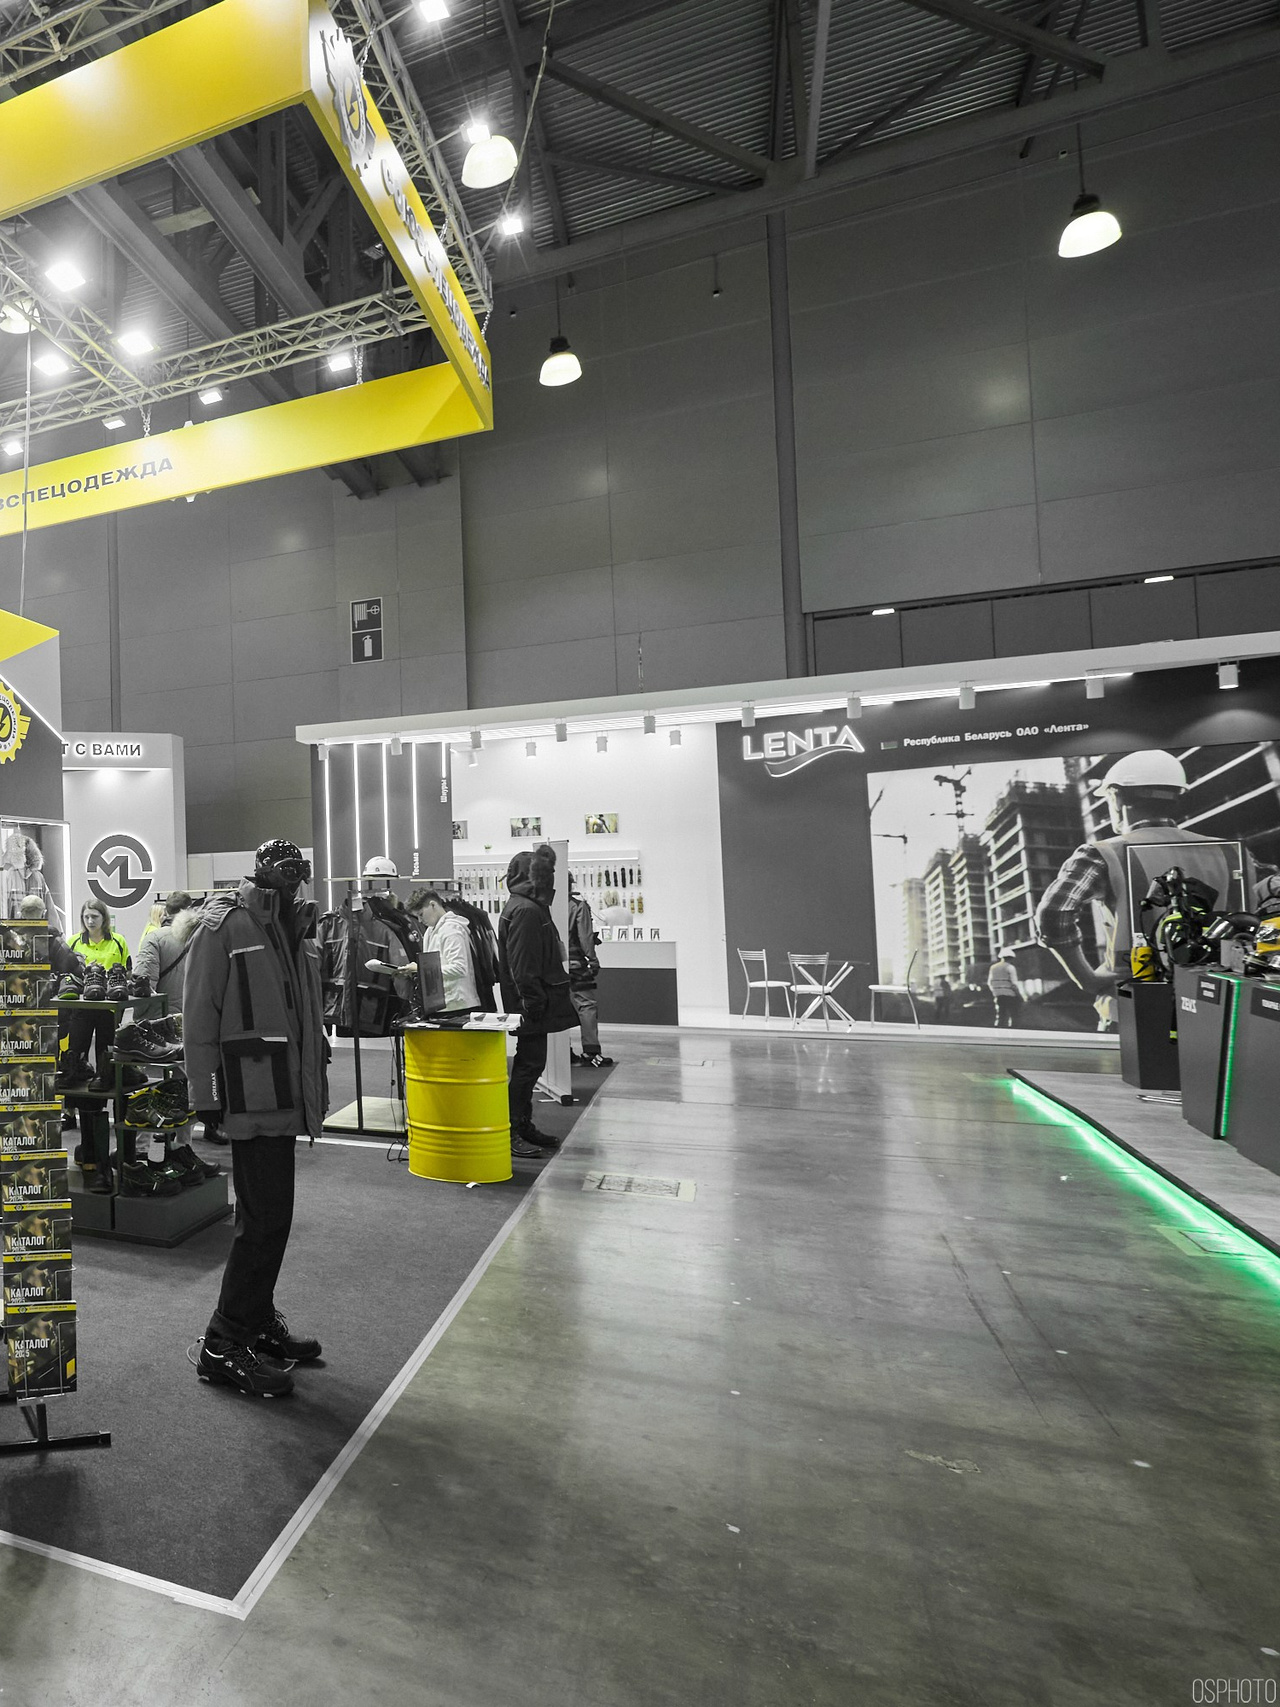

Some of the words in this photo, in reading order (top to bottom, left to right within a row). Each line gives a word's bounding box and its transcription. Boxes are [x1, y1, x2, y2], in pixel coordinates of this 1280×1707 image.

[903, 734, 961, 747] Республика
[964, 730, 1012, 742] Беларусь
[1016, 726, 1040, 737] ОАО
[1043, 722, 1090, 735] «Лента»
[742, 725, 866, 760] LENTA
[75, 743, 86, 755] С
[92, 743, 141, 756] ВАМИ
[1, 1040, 33, 1050] КАТАЛОГ
[3, 1136, 37, 1147] КАТАЛОГ
[8, 1185, 43, 1196] КАТАЛОГ
[11, 1236, 46, 1247] КАТАЛОГ
[10, 1287, 45, 1298] КАТАЛОГ
[14, 1338, 50, 1350] КАТАЛОГ
